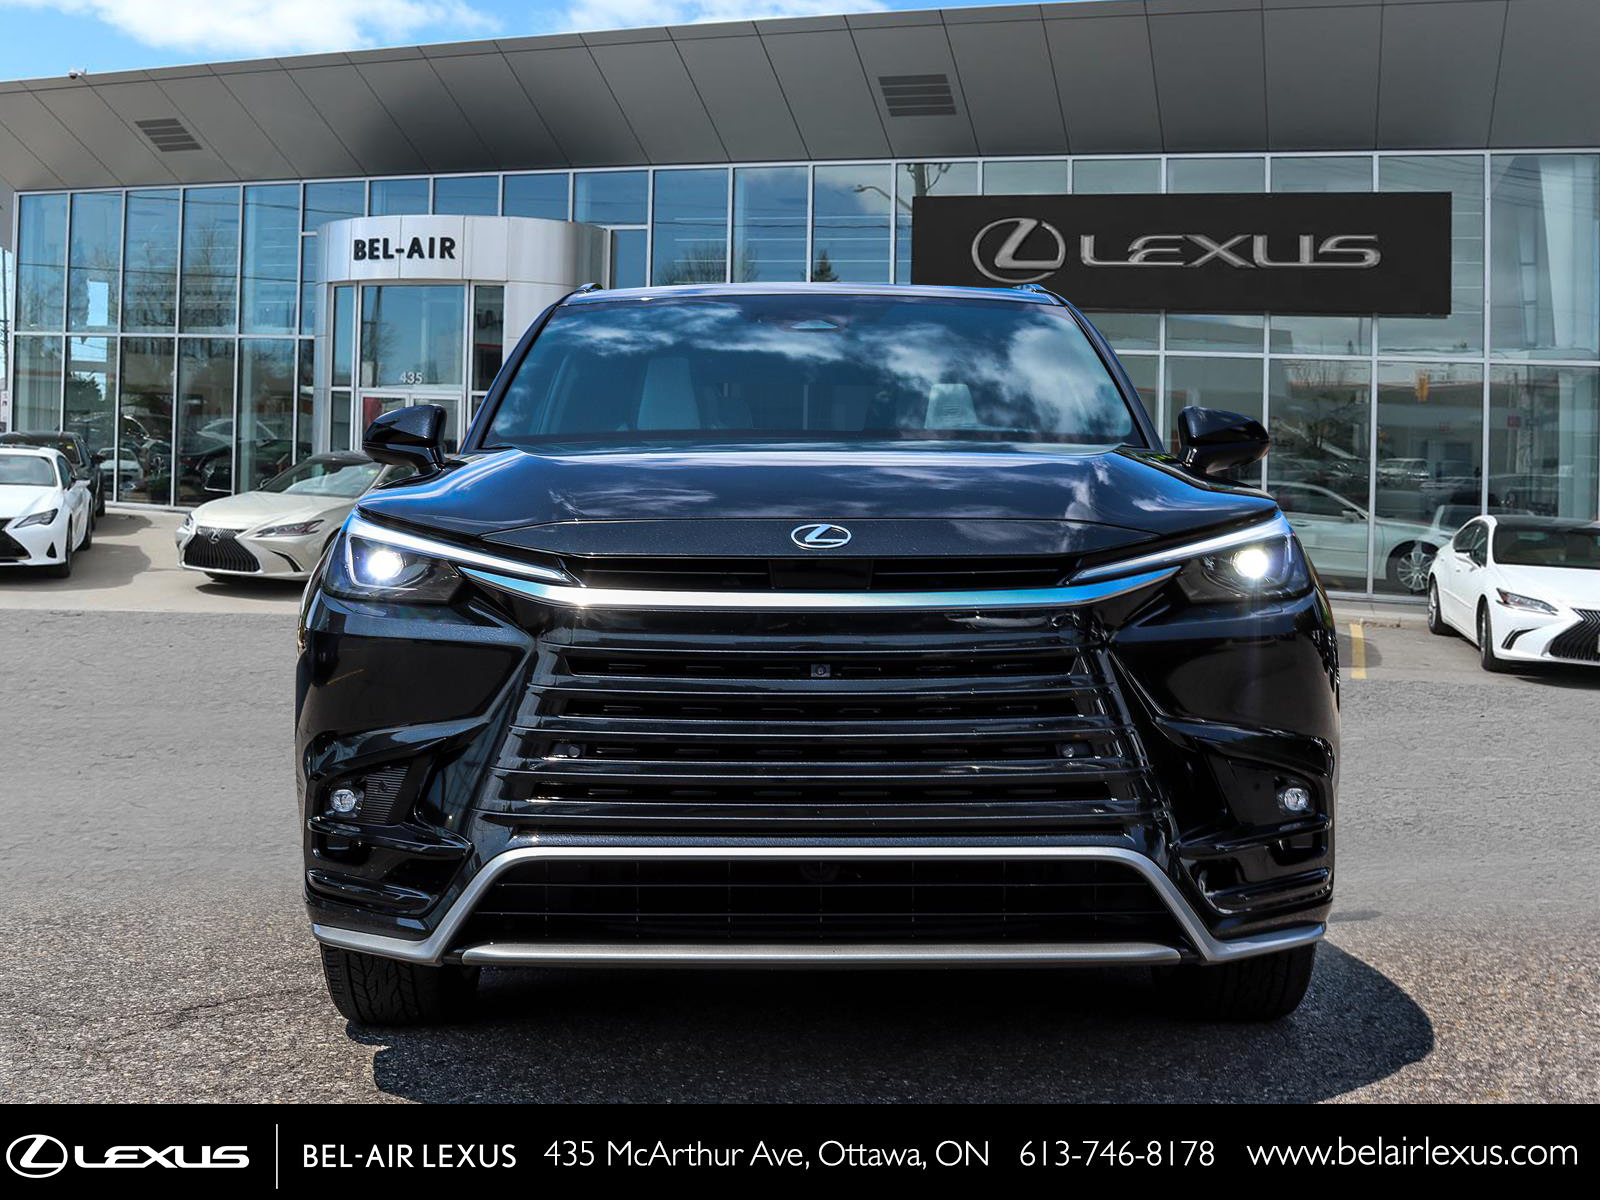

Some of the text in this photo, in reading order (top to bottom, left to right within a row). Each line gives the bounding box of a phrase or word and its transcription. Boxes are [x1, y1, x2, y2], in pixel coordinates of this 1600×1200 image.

[353, 237, 456, 261] BEL-AIR
[1079, 233, 1381, 269] LEXUS
[400, 371, 423, 385] 435
